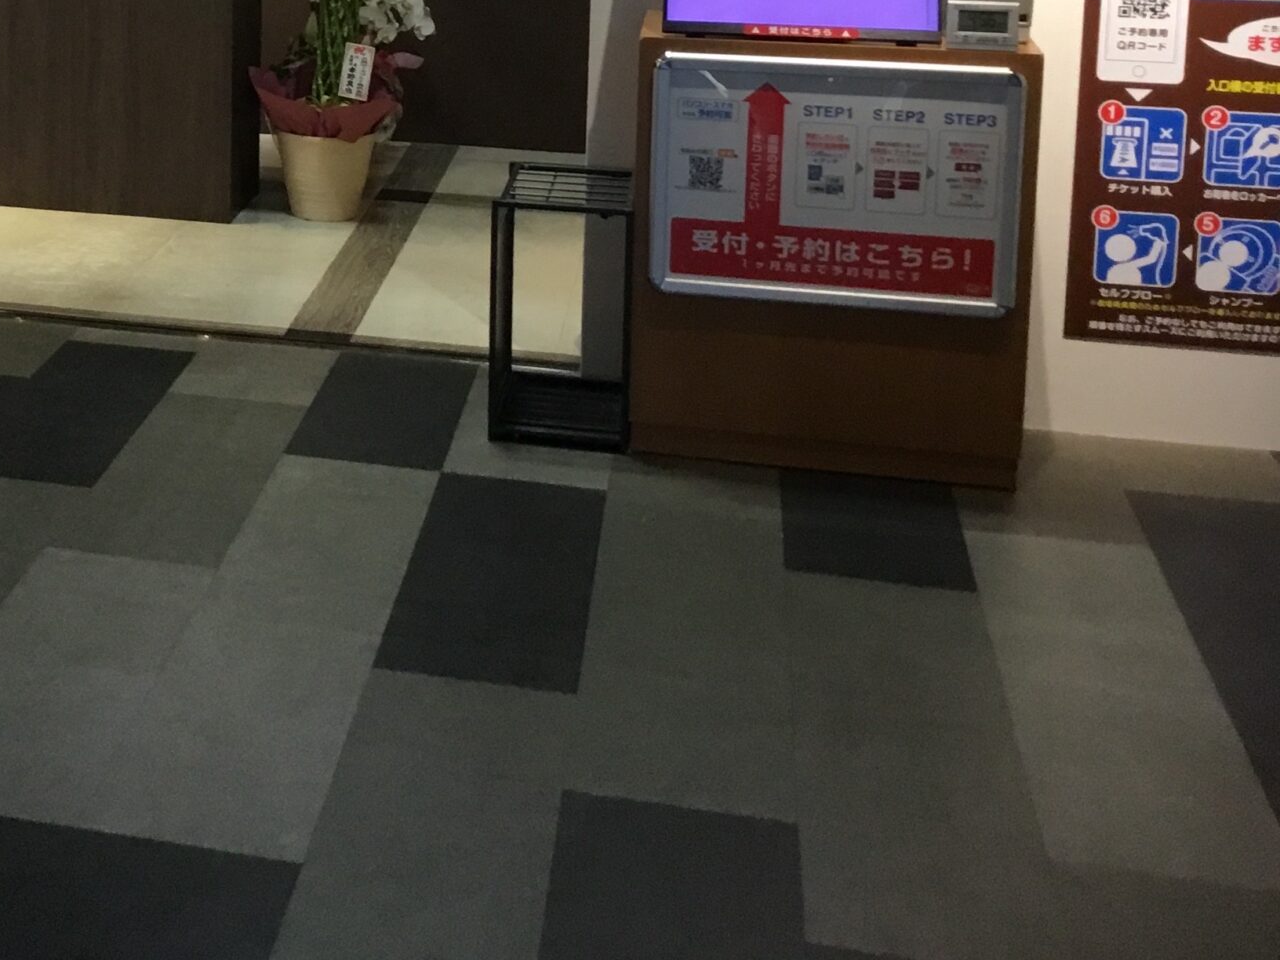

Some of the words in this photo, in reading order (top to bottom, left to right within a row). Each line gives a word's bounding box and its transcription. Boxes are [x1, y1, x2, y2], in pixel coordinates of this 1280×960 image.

[1117, 41, 1168, 51] QRコード
[803, 105, 853, 119] STEP1
[873, 109, 926, 124] STEP2
[944, 113, 997, 128] STEP3
[691, 229, 972, 271] 受付・予約はこちら!
